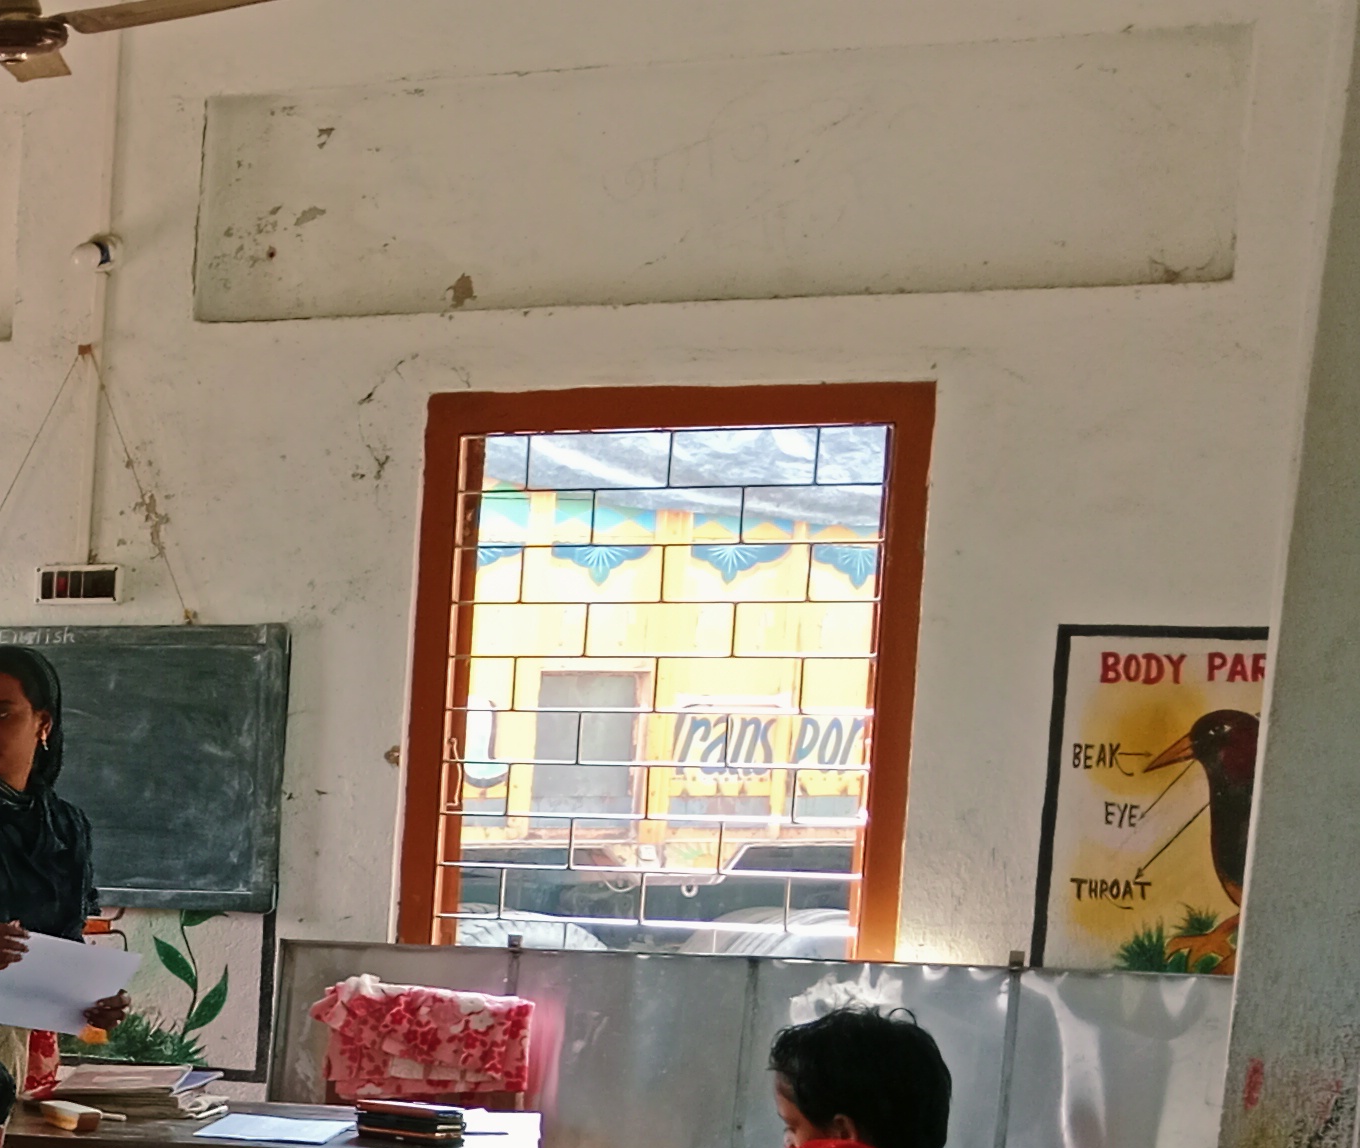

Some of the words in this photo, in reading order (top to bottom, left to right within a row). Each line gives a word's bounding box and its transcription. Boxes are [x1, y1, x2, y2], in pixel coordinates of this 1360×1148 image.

[1099, 652, 1187, 685] BODY
[1072, 743, 1135, 777] BEAK
[1104, 801, 1141, 828] EYE
[1070, 877, 1152, 902] THROAT
